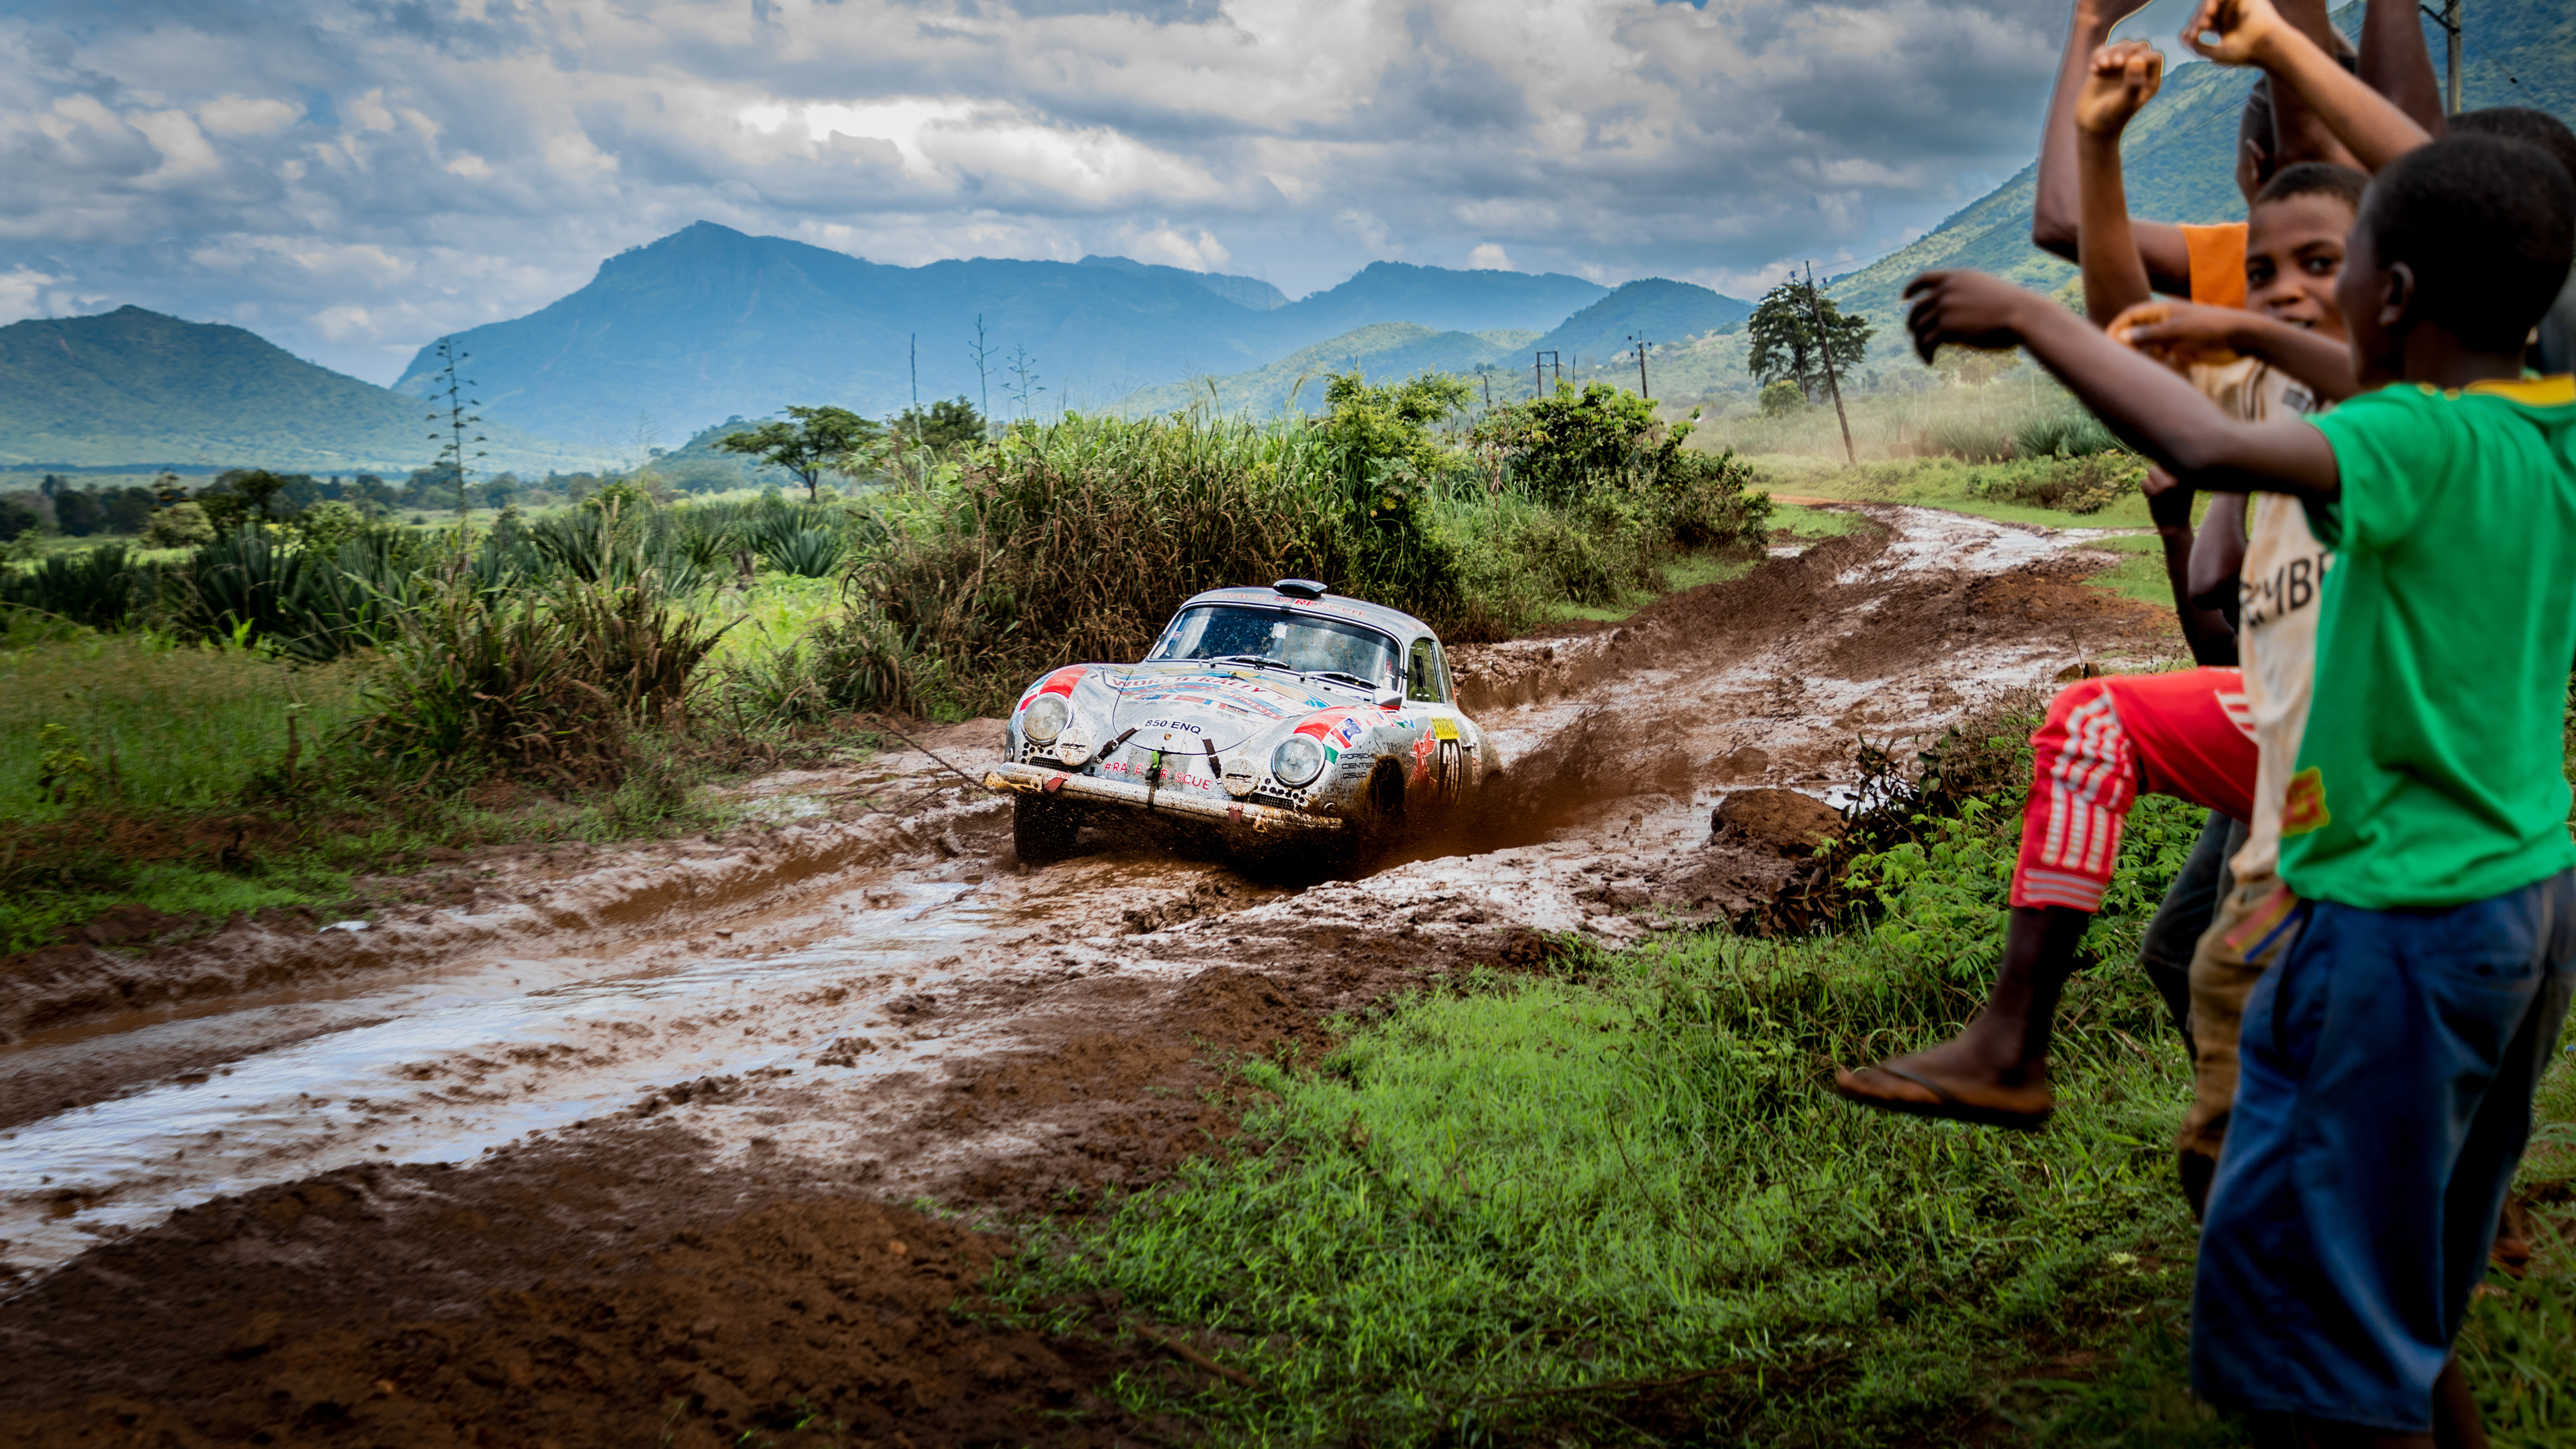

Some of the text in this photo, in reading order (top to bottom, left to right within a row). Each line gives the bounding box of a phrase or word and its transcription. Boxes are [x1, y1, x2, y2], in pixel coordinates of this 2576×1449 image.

[1294, 599, 1370, 619] RESCUE
[1113, 677, 1190, 687] WORLD
[1198, 677, 1267, 692] RALLY
[1211, 688, 1278, 718] CONTINENTS
[1171, 721, 1201, 735] ENQ
[1104, 762, 1144, 775] #RAE
[1160, 769, 1211, 790] RSCUE
[1228, 802, 1244, 811] TOW
